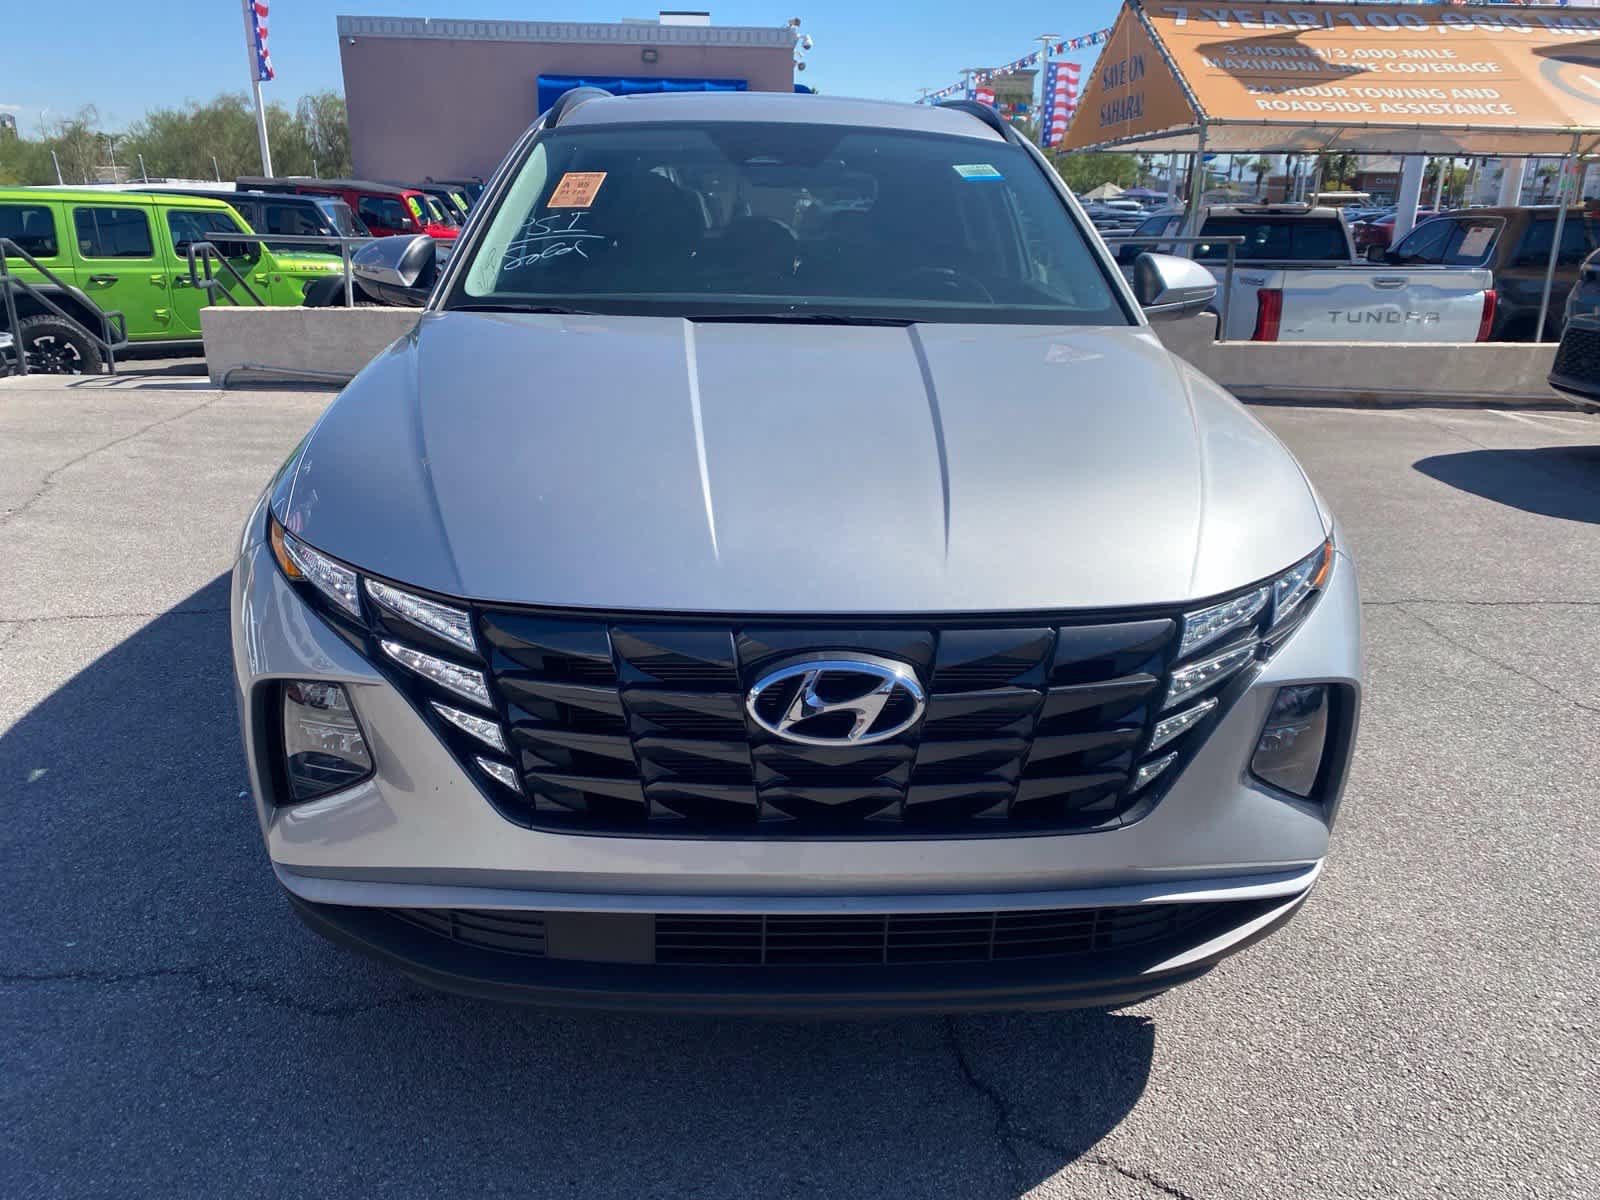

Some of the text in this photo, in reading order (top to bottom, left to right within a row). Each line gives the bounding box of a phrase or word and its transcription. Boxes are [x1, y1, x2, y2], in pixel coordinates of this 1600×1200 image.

[1104, 55, 1145, 90] SAVE ON
[1201, 56, 1503, 74] MAXIMUM CARE COVERAGE
[1351, 87, 1447, 99] TOWING
[1451, 88, 1501, 100] AND
[1255, 99, 1517, 115] ROADSIDE ASSISTANCE
[1328, 311, 1441, 325] TUNDRA
